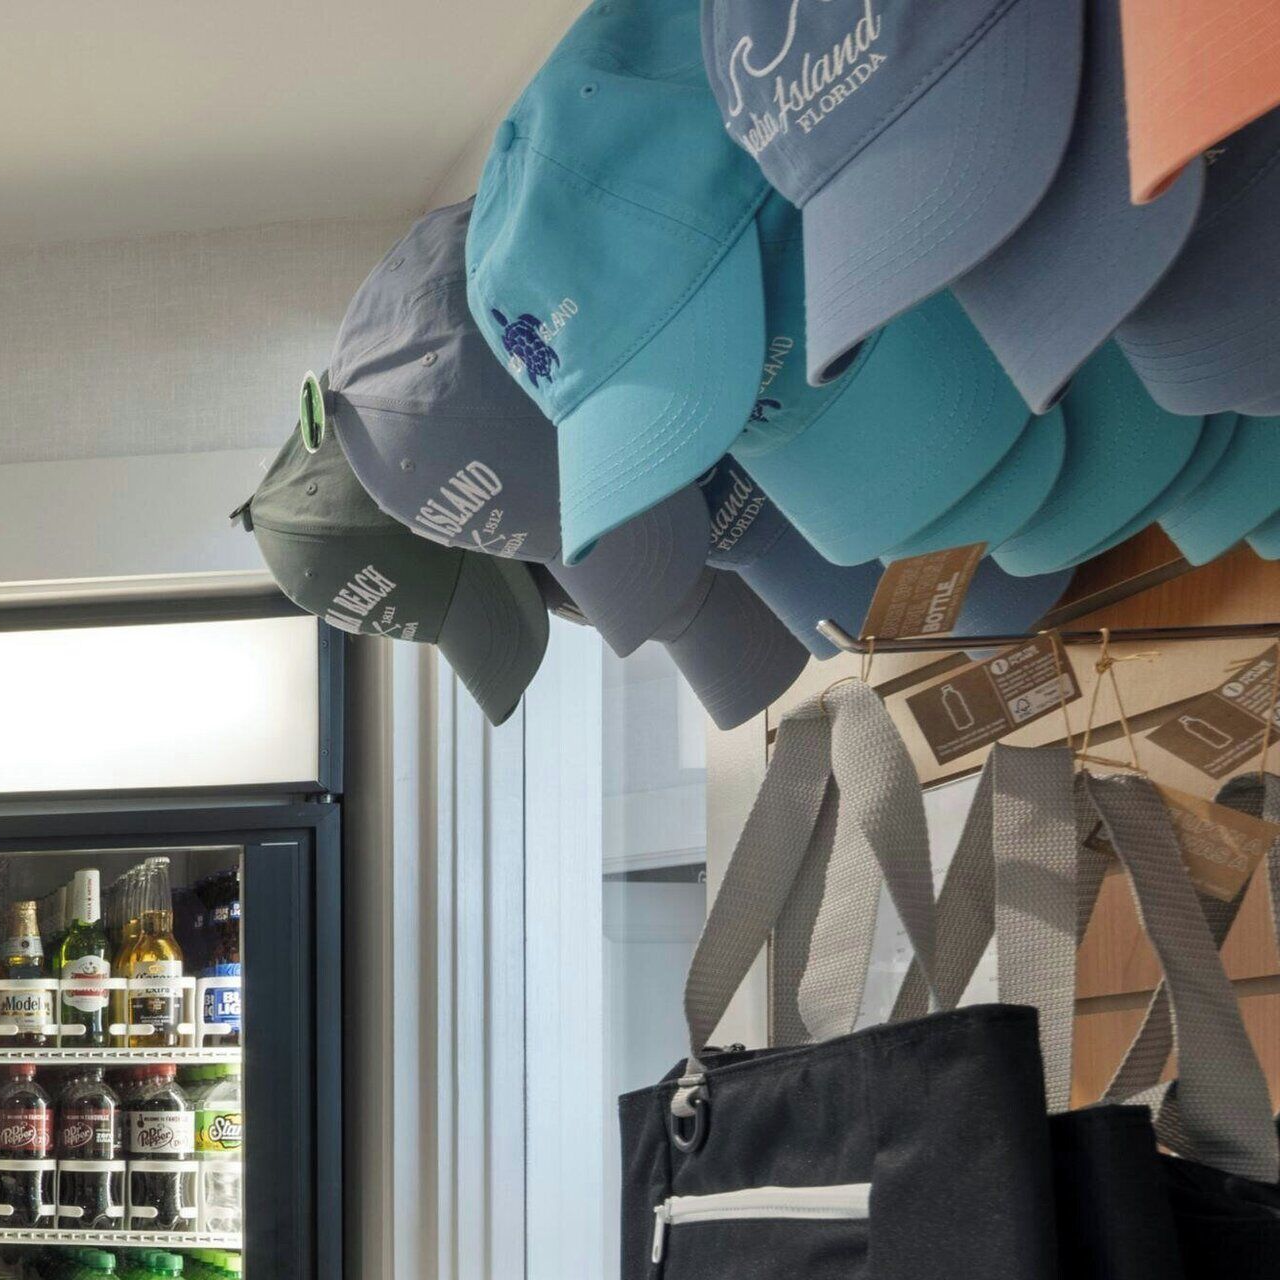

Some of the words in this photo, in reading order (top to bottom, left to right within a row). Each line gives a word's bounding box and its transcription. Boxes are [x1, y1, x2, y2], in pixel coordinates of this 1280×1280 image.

[795, 53, 888, 134] FLORIDA
[760, 336, 794, 393] LAND
[415, 460, 503, 538] ISLAND
[483, 509, 504, 535] 1812
[719, 495, 765, 558] FLORIDA
[333, 565, 397, 616] BEACH
